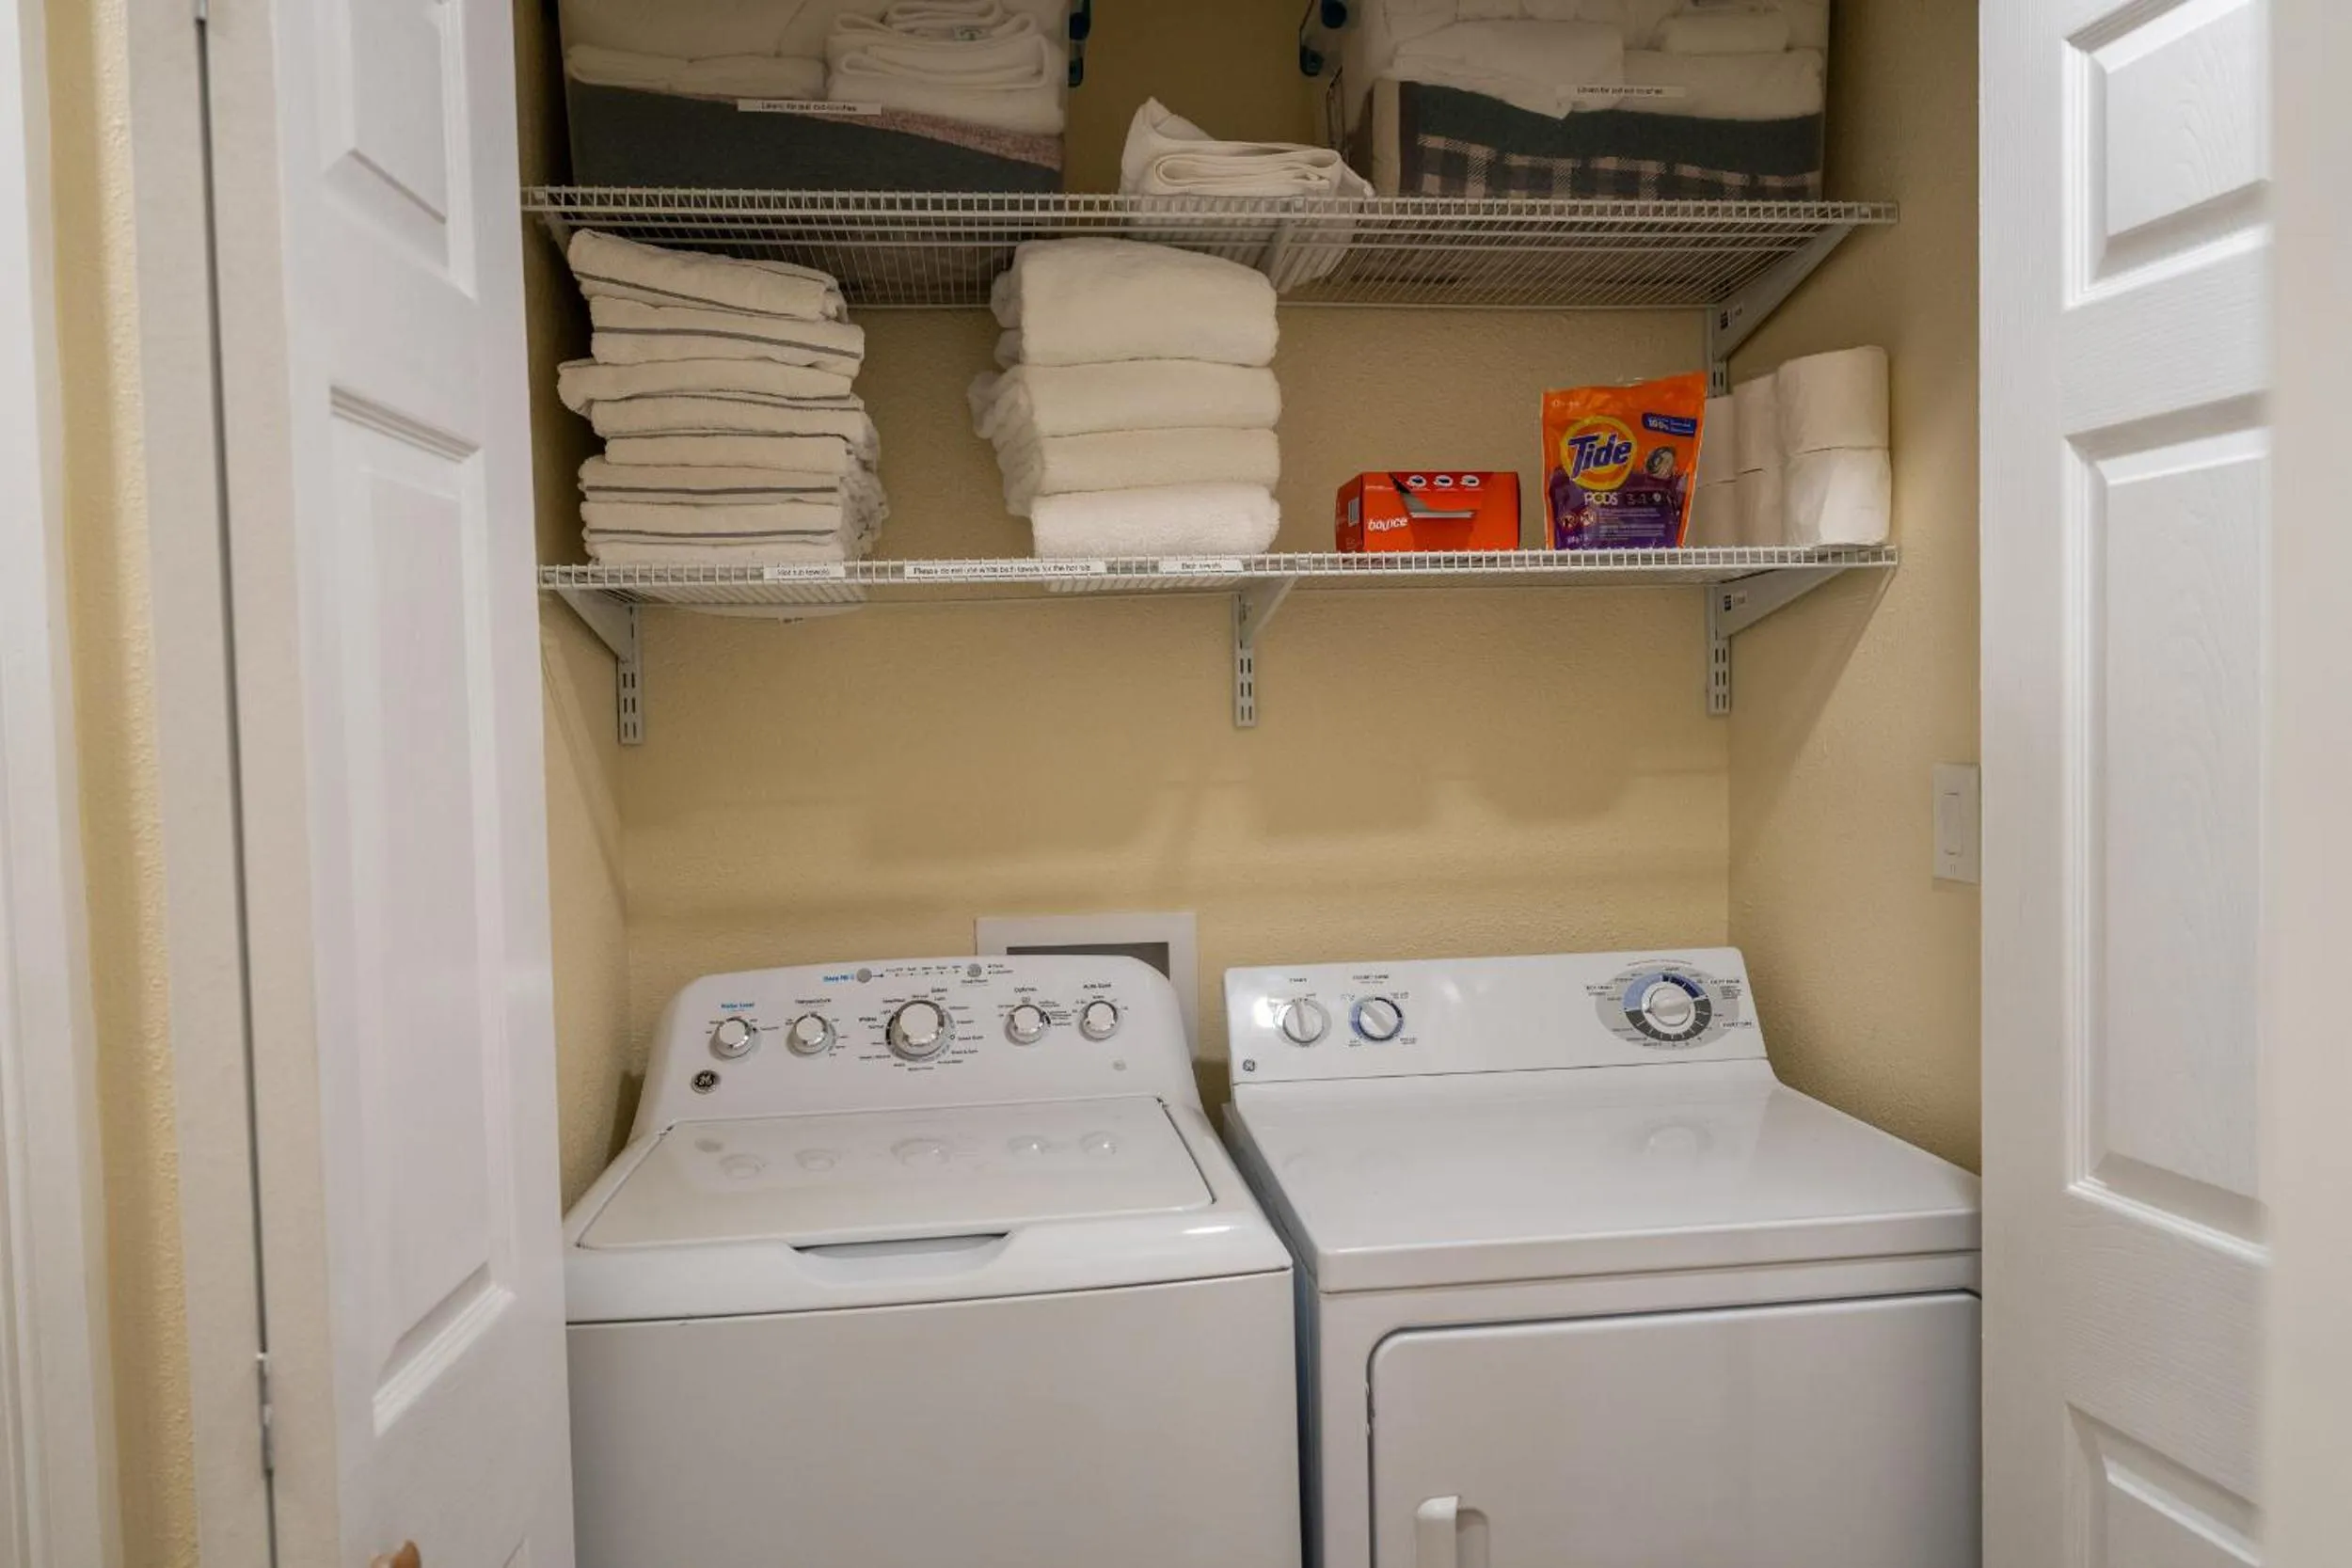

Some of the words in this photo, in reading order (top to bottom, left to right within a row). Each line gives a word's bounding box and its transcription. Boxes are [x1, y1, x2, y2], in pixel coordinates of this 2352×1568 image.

[1567, 432, 1632, 478] Tide
[1584, 491, 1618, 505] PODS
[1368, 516, 1407, 532] bounce
